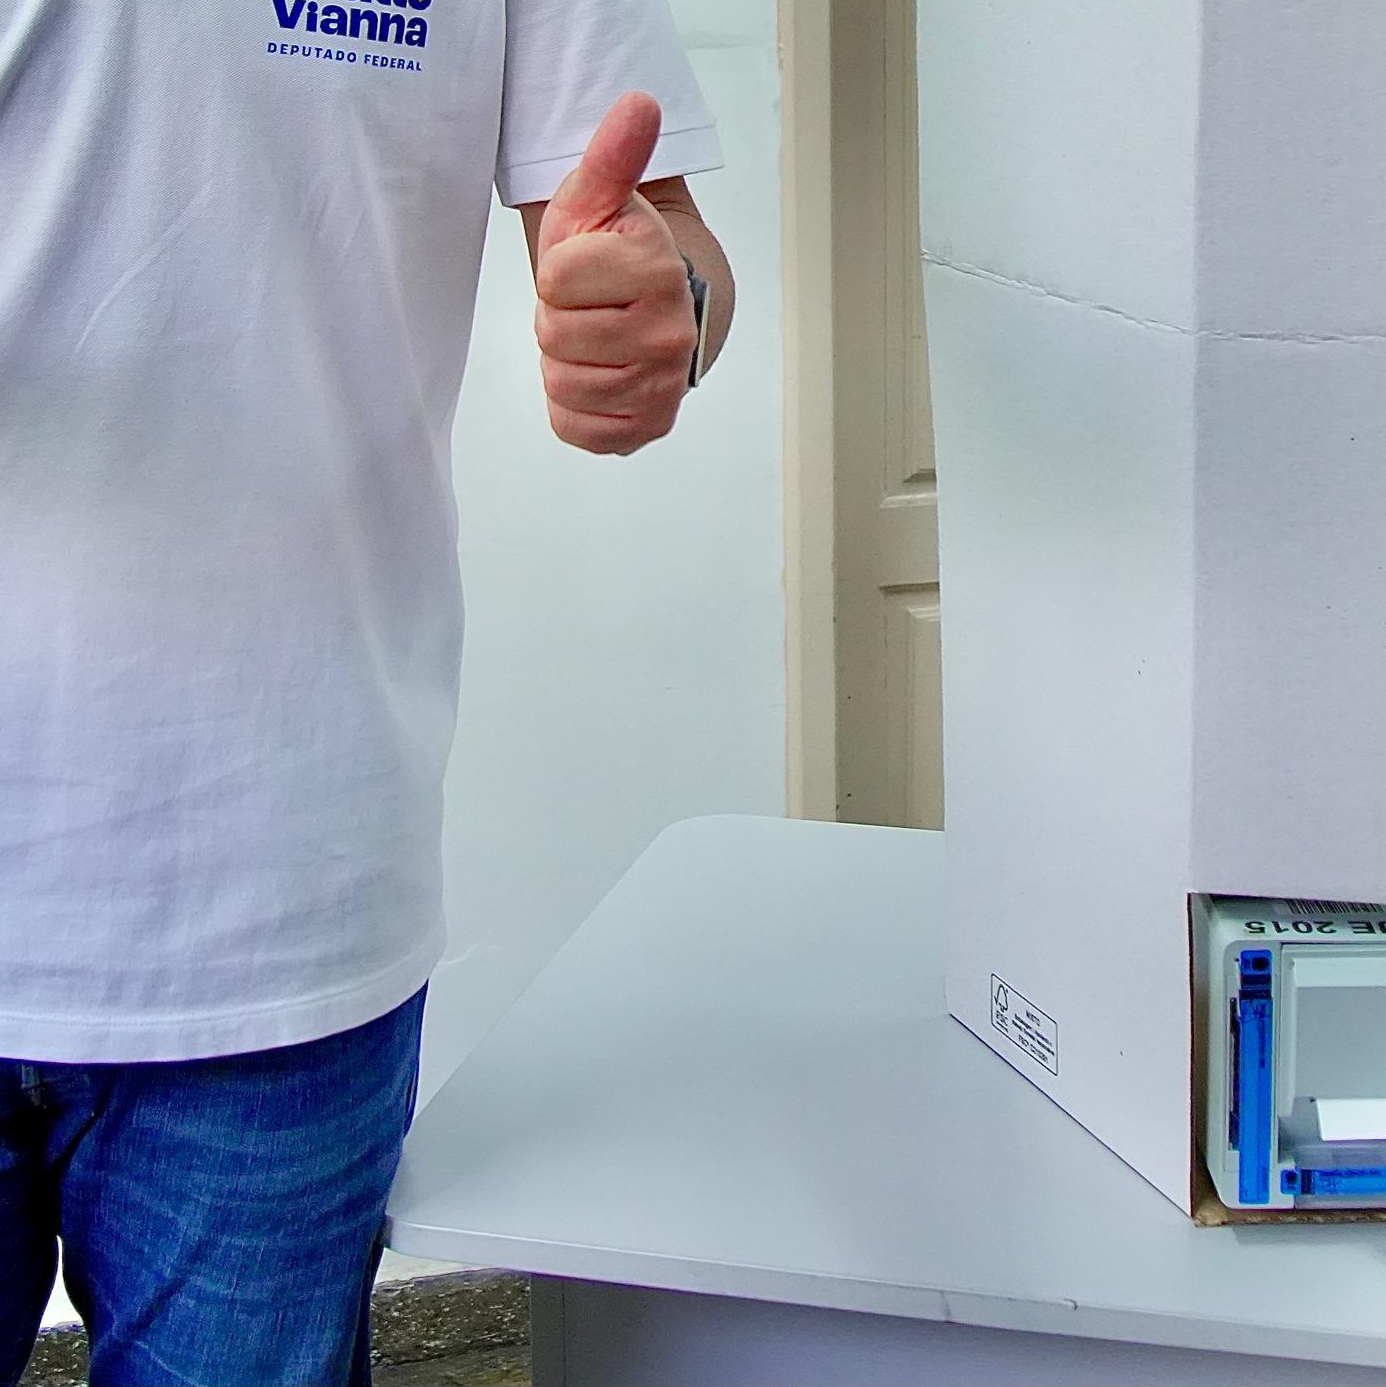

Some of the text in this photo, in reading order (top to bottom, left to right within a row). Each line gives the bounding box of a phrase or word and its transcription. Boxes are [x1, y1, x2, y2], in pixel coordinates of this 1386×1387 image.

[268, 42, 422, 71] DEPUTADO FEDERAL
[1244, 921, 1337, 934] 2015
